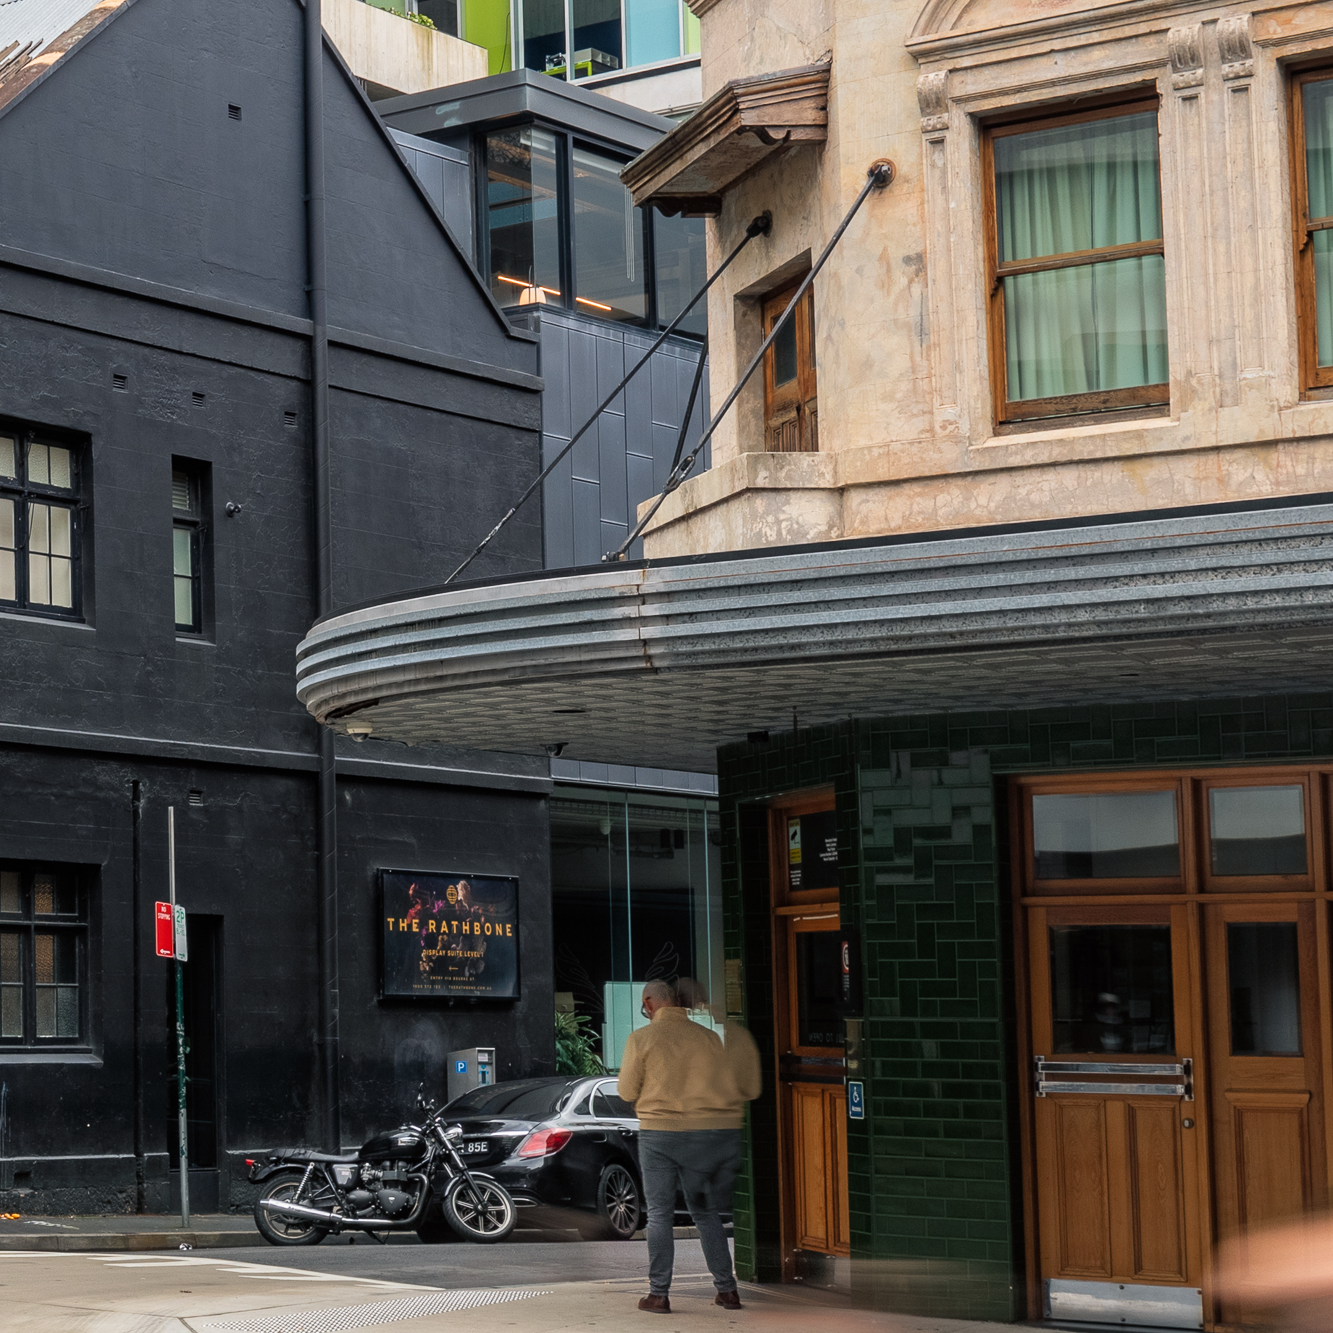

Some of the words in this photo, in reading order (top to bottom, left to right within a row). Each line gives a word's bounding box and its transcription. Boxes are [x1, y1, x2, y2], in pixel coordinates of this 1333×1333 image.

[175, 910, 185, 924] 2P
[387, 918, 419, 932] THE
[428, 919, 513, 937] RATHBONE
